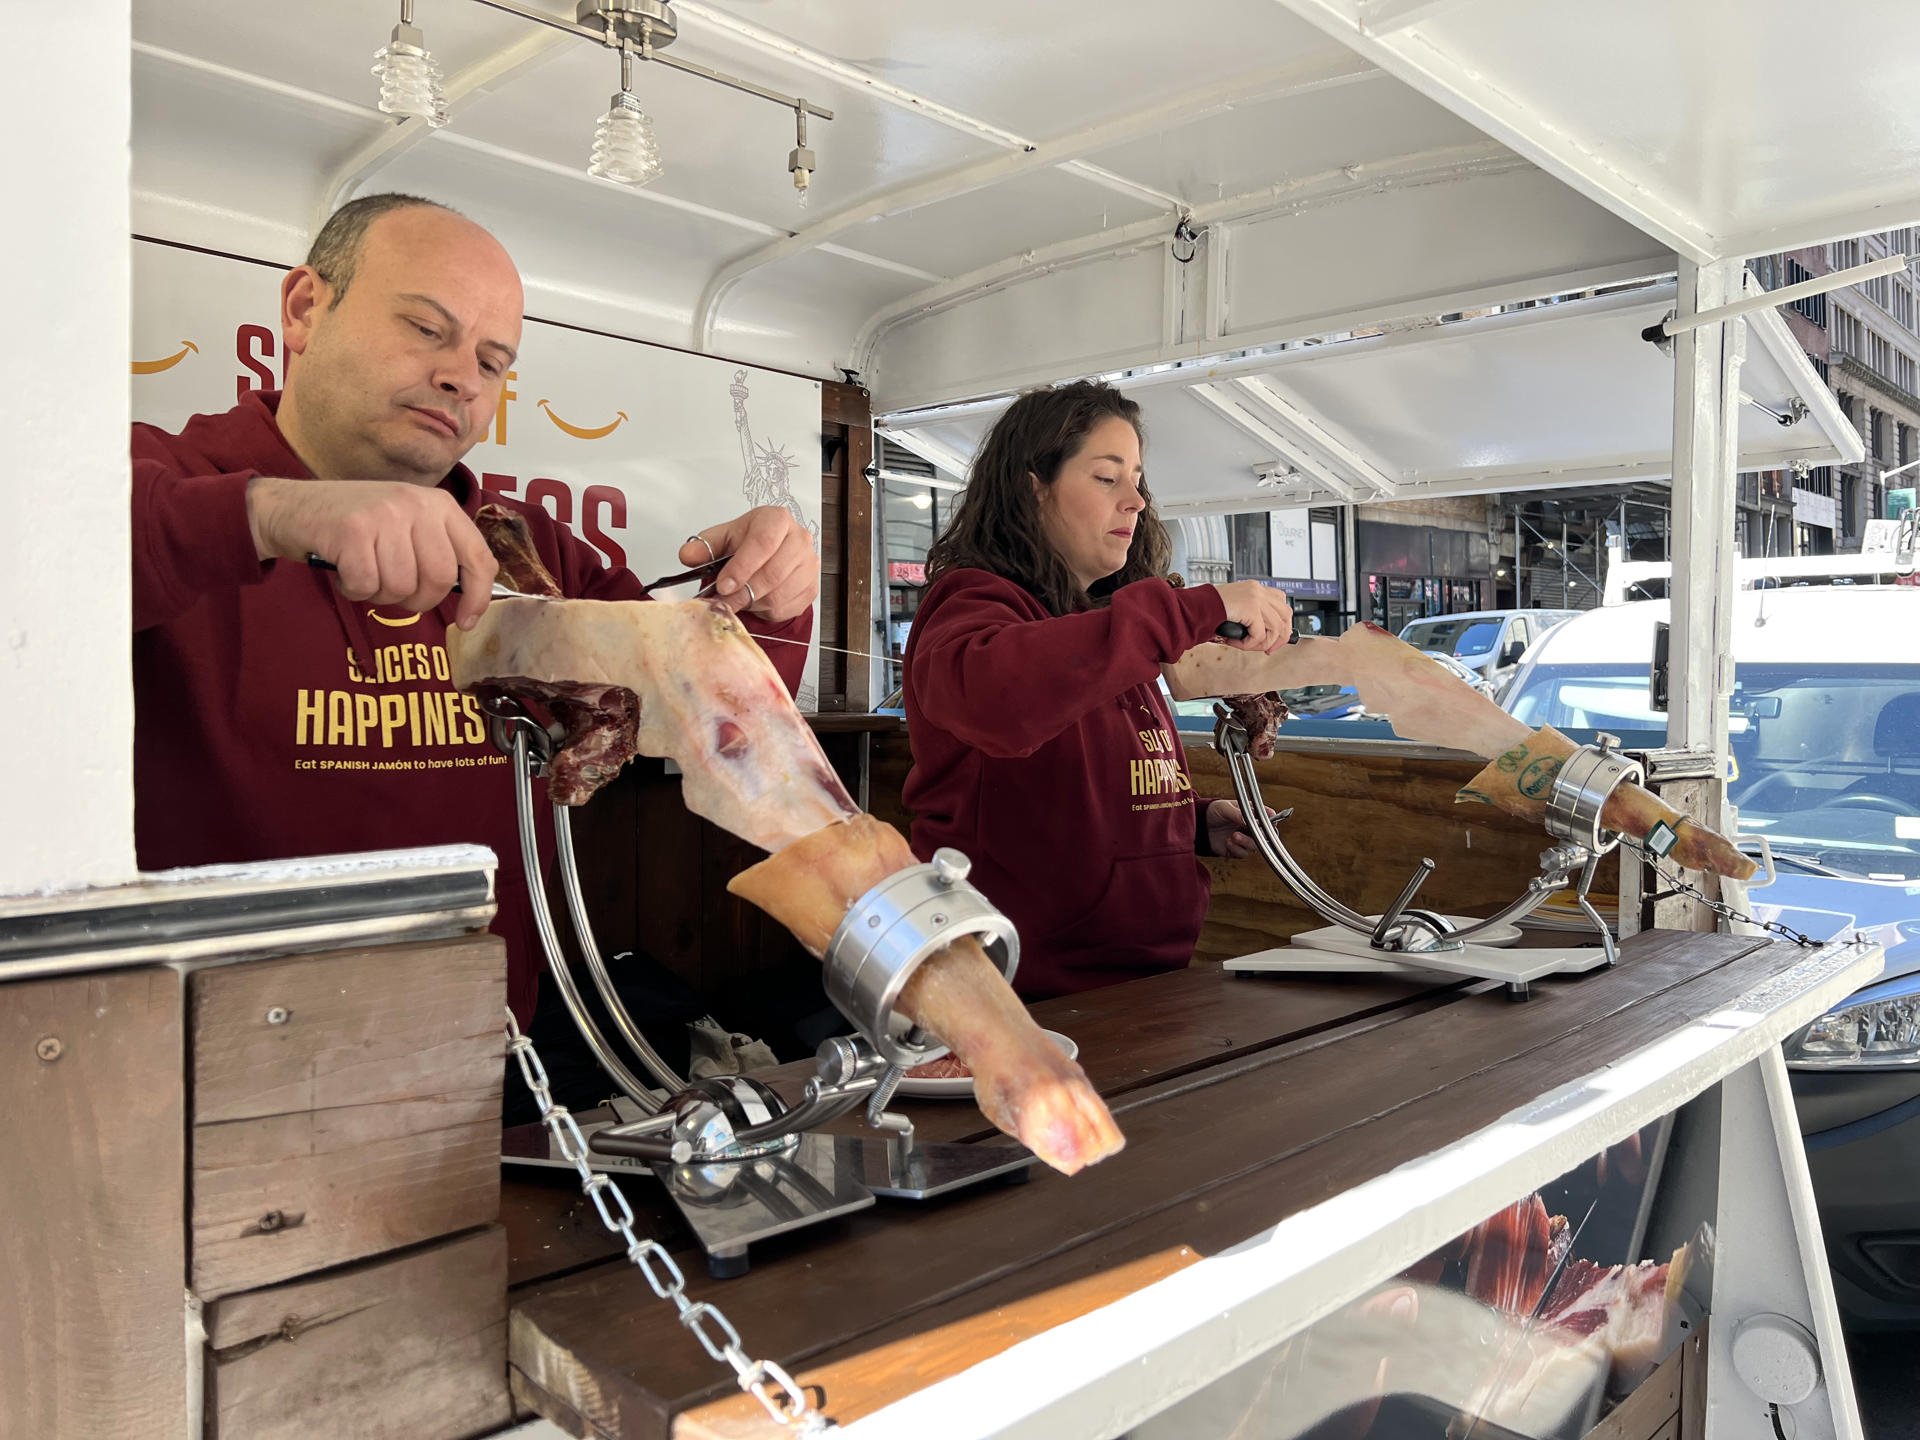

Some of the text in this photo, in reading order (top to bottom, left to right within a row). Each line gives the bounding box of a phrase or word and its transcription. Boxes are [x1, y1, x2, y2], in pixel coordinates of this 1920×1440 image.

[347, 643, 450, 684] SICES O
[296, 688, 486, 748] HAPPINES
[294, 755, 508, 770] Eat SPANISH JAMÓN to have lots of fun!
